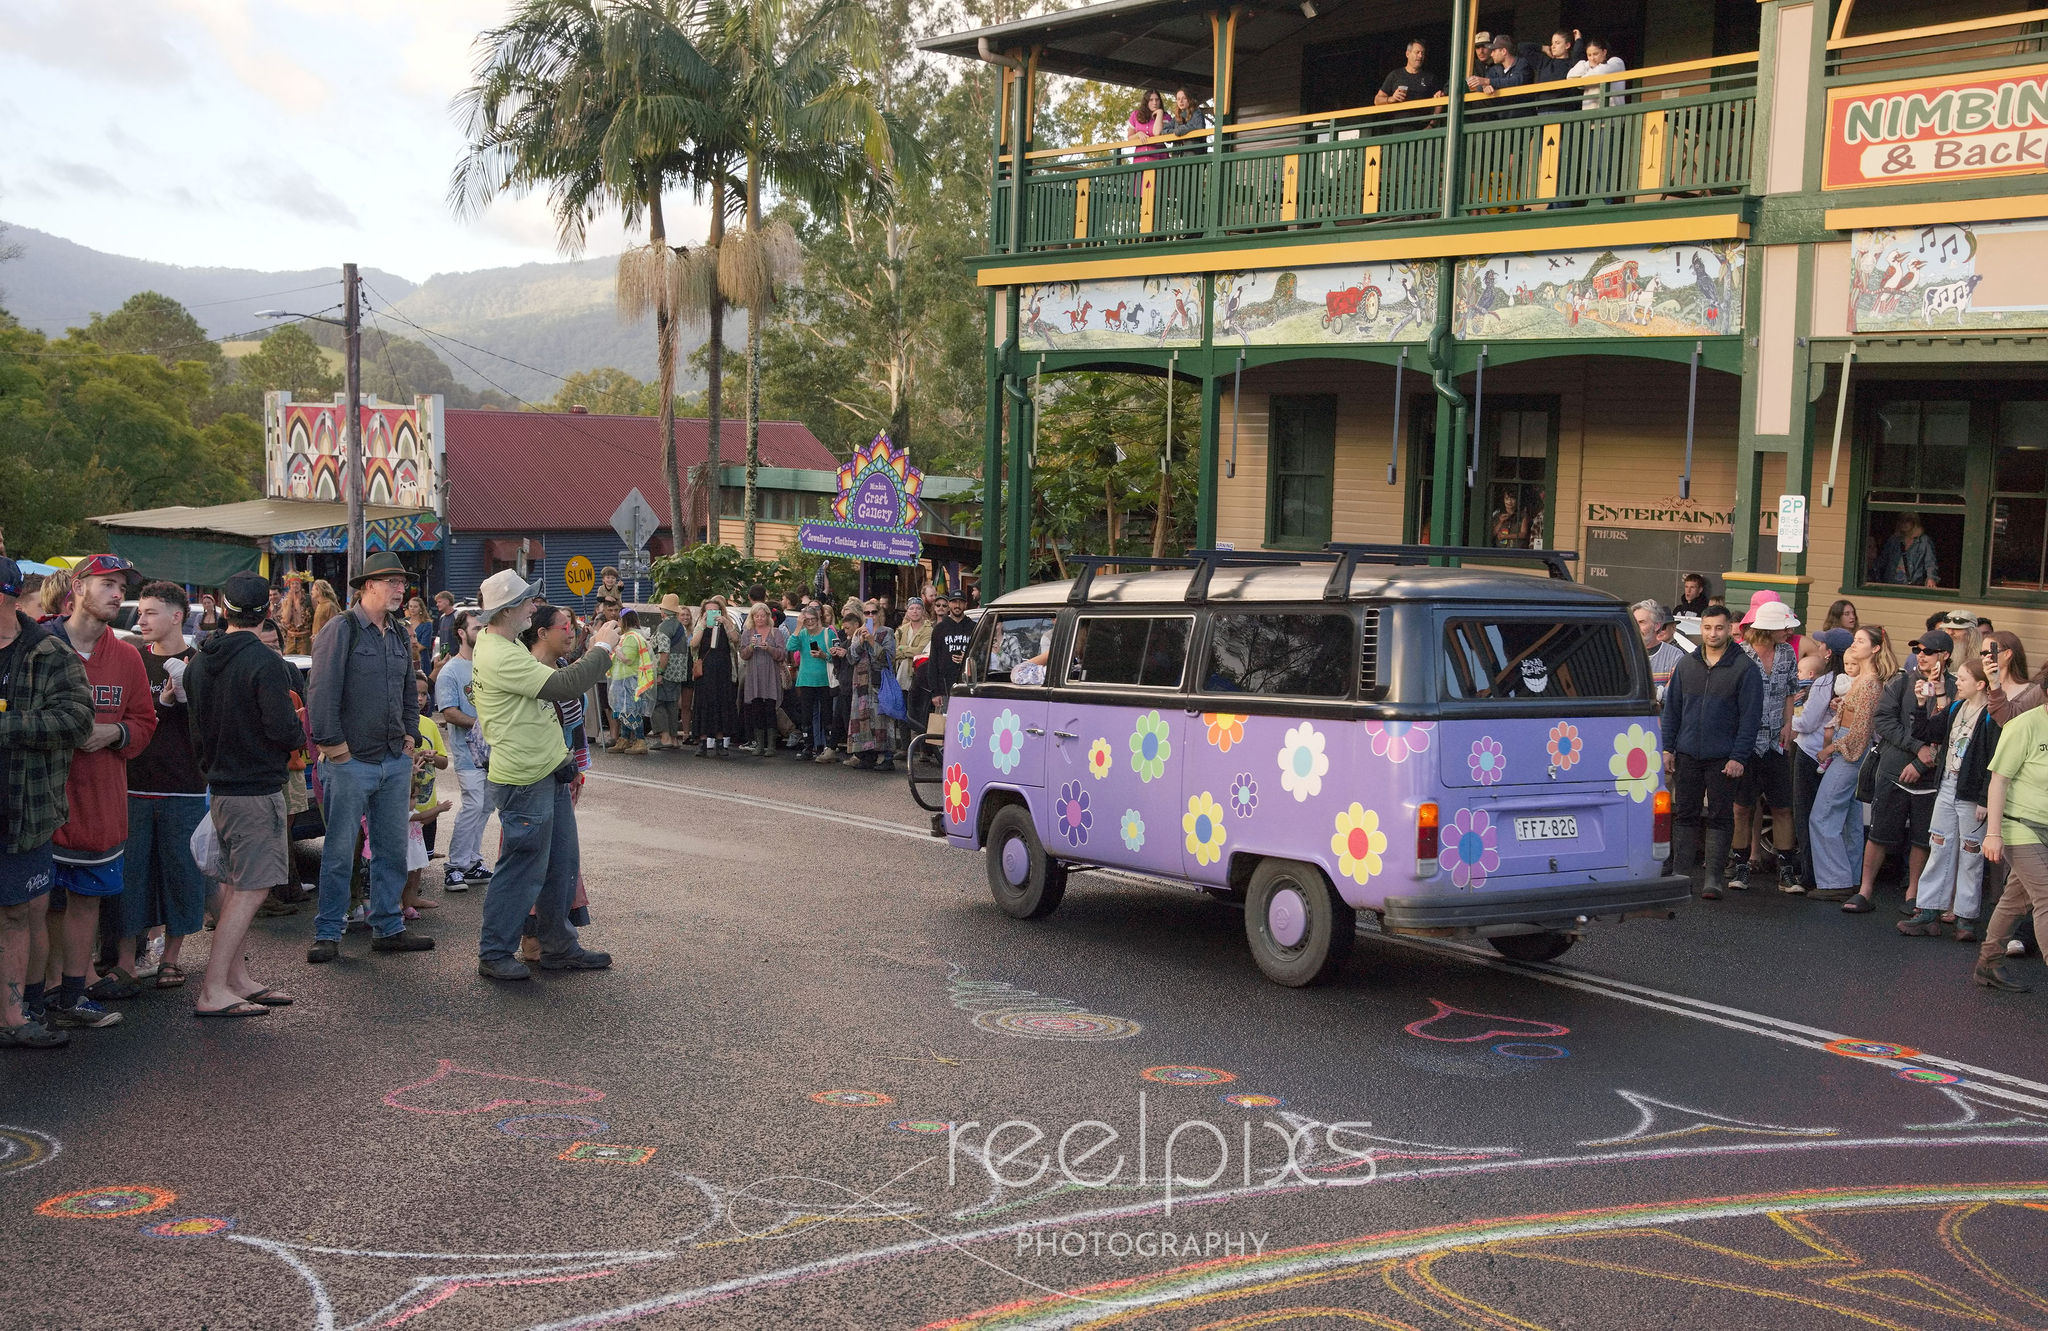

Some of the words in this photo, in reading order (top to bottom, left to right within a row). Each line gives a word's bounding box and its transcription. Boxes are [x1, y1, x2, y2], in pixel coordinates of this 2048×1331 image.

[1844, 82, 2048, 145] NIMBIN
[1881, 144, 1916, 174] &
[1934, 132, 2048, 170] Back
[864, 492, 888, 504] Craft
[1782, 500, 1803, 513] 2P
[858, 504, 893, 522] Gallery
[1588, 503, 1778, 530] ENTERTAINMT
[807, 533, 832, 545] Jewellery
[834, 536, 857, 548] Clothing
[860, 540, 869, 548] Art
[872, 541, 886, 550] Gifts
[891, 537, 914, 548] Smoking
[567, 568, 593, 584] SLOW
[90, 685, 123, 706] CH
